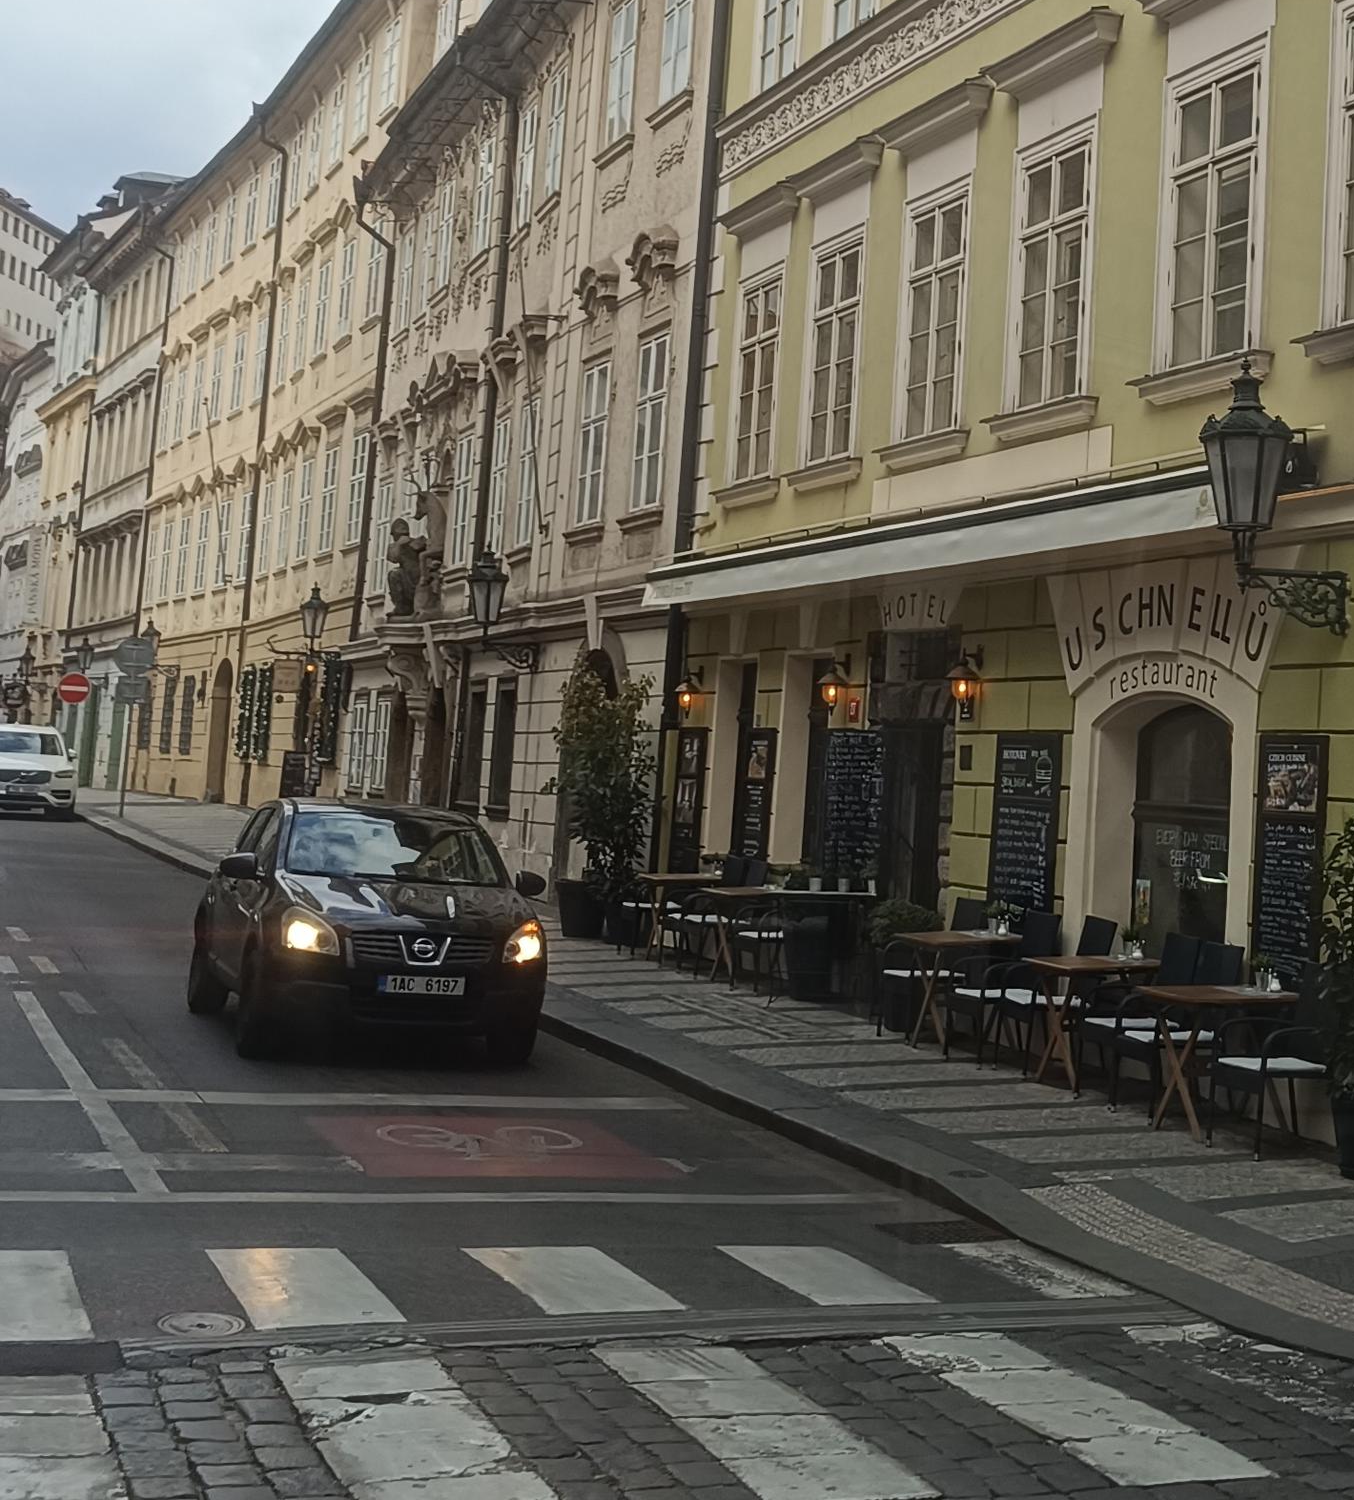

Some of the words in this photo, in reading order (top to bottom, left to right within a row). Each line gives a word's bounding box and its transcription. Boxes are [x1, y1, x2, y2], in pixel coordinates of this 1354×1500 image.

[883, 593, 946, 627] HOTEL
[1065, 627, 1083, 671] U
[1092, 583, 1268, 662] SCHNELLŮ
[1109, 660, 1217, 700] restaurant
[391, 977, 416, 992] 1AC
[425, 978, 459, 993] 6197
